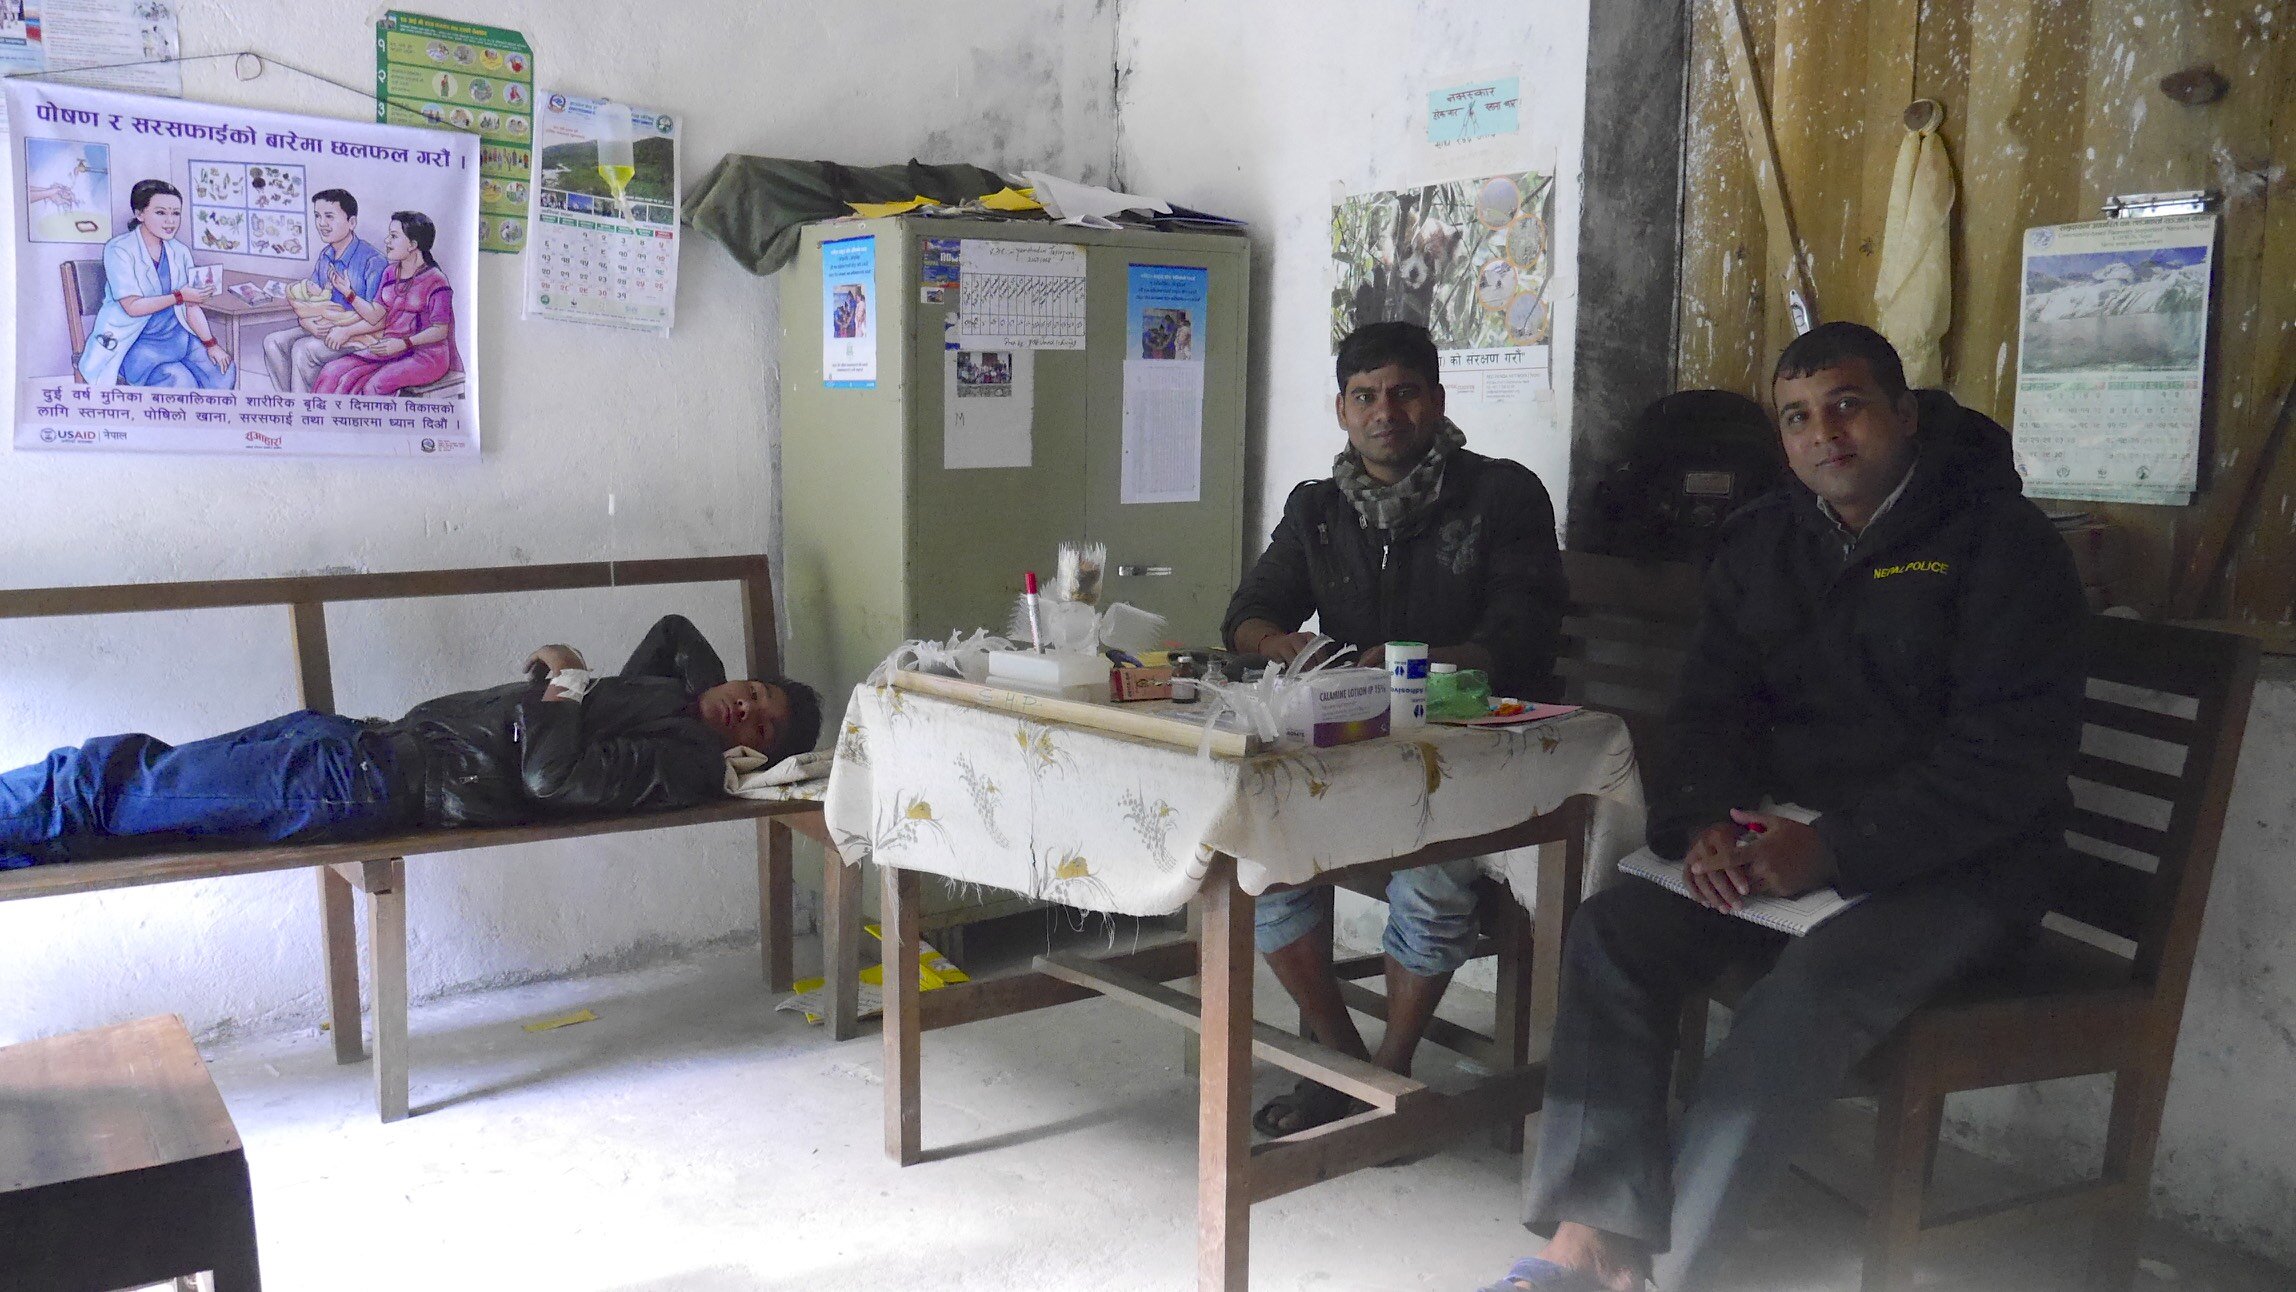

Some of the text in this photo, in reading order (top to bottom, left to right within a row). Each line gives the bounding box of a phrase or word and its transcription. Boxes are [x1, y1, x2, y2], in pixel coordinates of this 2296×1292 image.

[36, 101, 100, 128] पोषण
[108, 114, 124, 131] र
[132, 116, 257, 145] सरसफाईको
[265, 131, 323, 153] बारेमा
[331, 139, 410, 163] छलफल
[416, 148, 451, 168] गरौं
[1450, 352, 1461, 366] को
[1466, 351, 1500, 366] संरक्षण
[42, 386, 63, 402] दुई
[72, 387, 91, 401] वर्ष
[101, 389, 143, 405] मुनिका
[151, 391, 237, 406] बालबालिकाको
[245, 395, 295, 408] शारीरिक
[335, 402, 342, 410] र
[349, 398, 398, 413] दिमागको
[405, 400, 455, 414] विकासको
[37, 404, 69, 418] लागि
[78, 408, 136, 421] स्तनपान,
[144, 408, 187, 421] पोषिलो
[195, 411, 232, 424] खाना,
[240, 413, 293, 426] सरसफाई
[301, 414, 325, 426] तथा
[332, 415, 382, 428] स्याहारमा
[57, 430, 96, 440] USAID
[103, 428, 128, 440] नेपाल
[1873, 561, 1949, 579] NEPAL POLICE
[1320, 688, 1347, 702] CALAMINE
[1347, 686, 1367, 697] LOTION
[1368, 686, 1374, 695] IP
